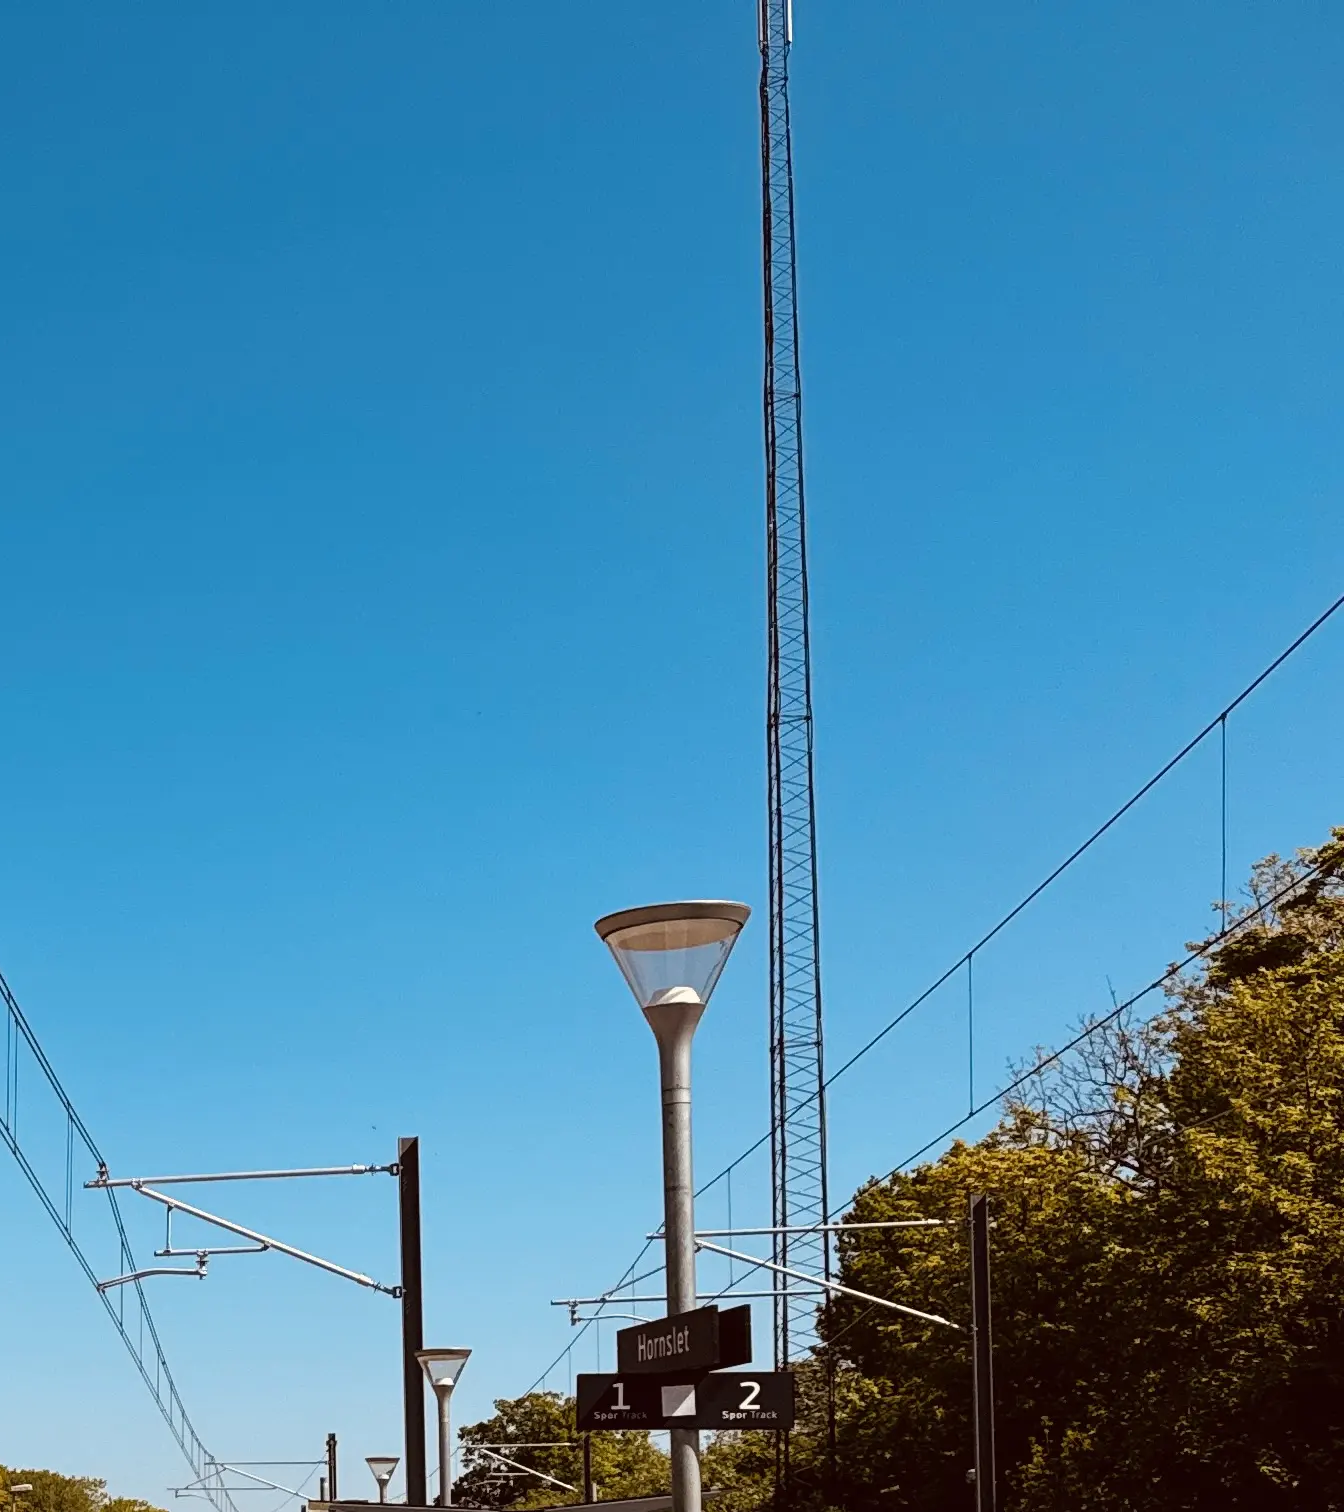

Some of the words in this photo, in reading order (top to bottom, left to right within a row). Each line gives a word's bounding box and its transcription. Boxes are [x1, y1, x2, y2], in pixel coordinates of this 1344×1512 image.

[637, 1325, 690, 1363] Hornslet
[610, 1382, 631, 1410] 1
[738, 1381, 761, 1410] 2
[593, 1411, 618, 1421] Spor
[622, 1411, 648, 1420] Track
[722, 1410, 747, 1420] Spor
[750, 1410, 779, 1419] Track
